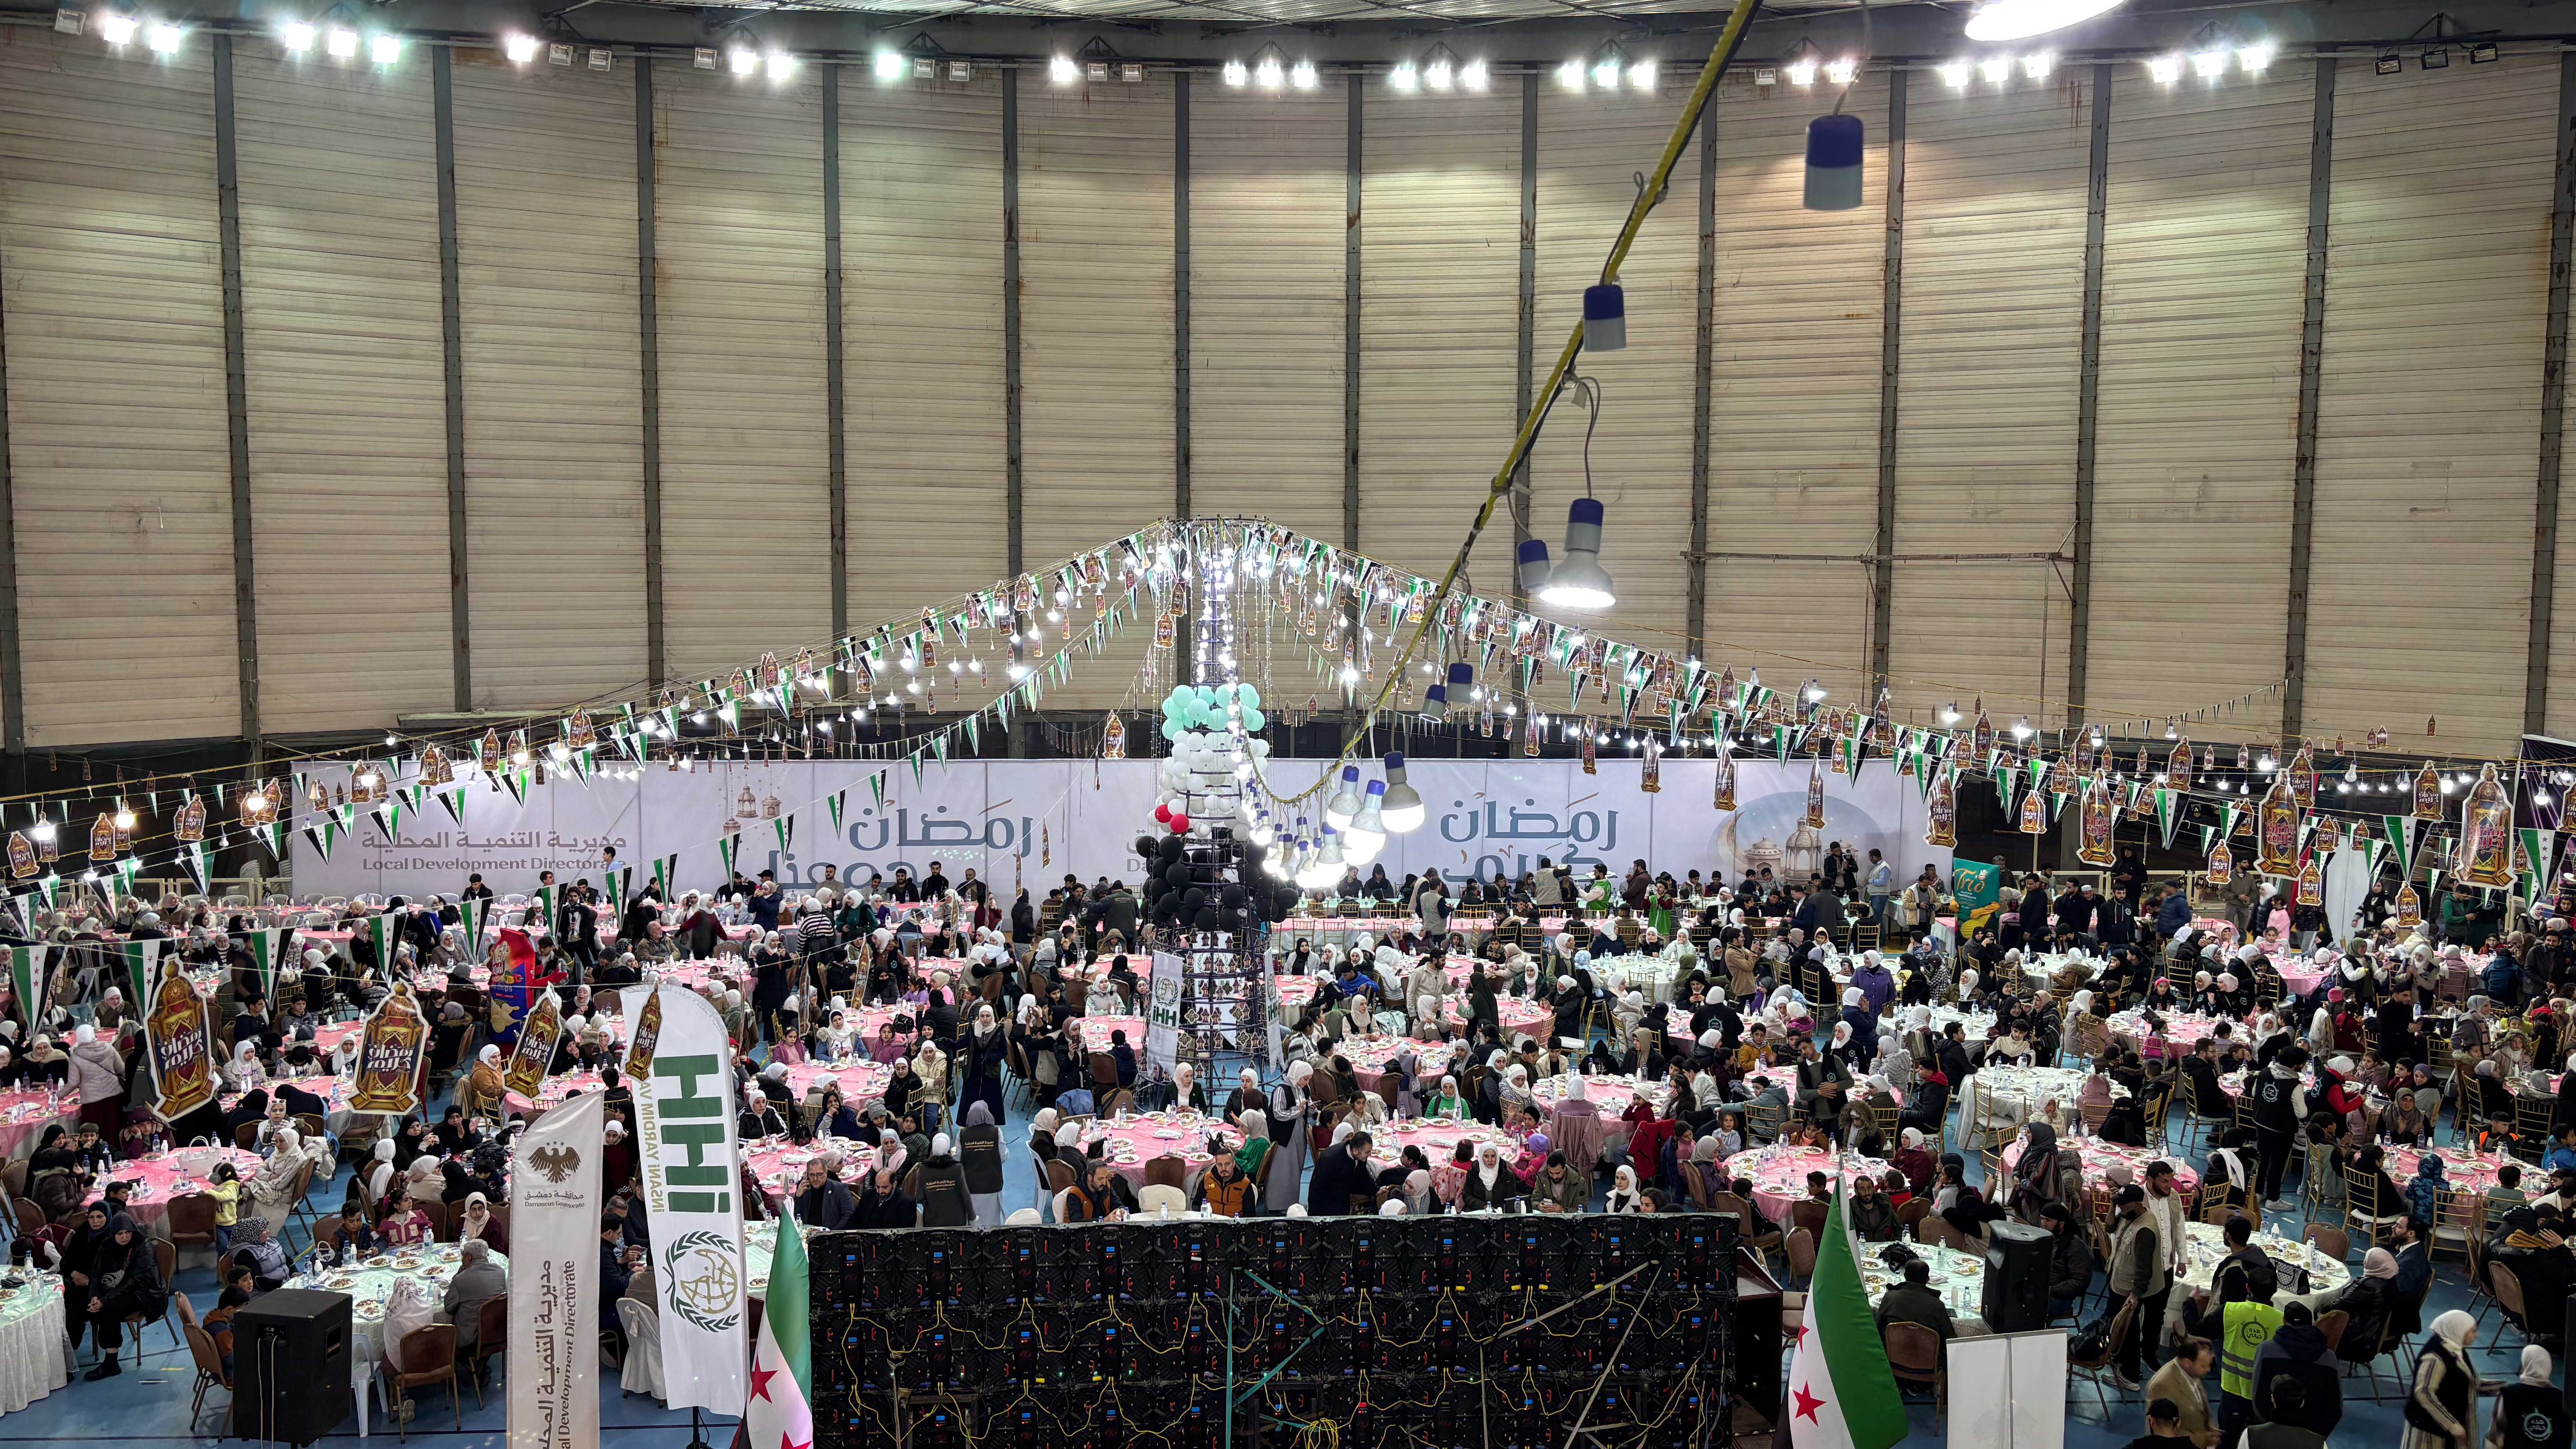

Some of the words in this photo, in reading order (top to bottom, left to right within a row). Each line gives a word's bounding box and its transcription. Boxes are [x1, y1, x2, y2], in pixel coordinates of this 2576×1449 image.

[361, 830, 449, 852] المحلية
[456, 830, 541, 852] التنمية
[547, 830, 627, 854] مديرية
[363, 858, 409, 870] Local
[413, 858, 527, 873] Development
[530, 858, 627, 870] Directorae
[161, 1027, 202, 1056] رمضان
[368, 1043, 414, 1060] رمضان
[162, 1039, 205, 1072] كريم
[367, 1055, 412, 1071] كريم
[524, 1191, 552, 1200] دمشق
[554, 1190, 584, 1200] محافظة
[534, 1260, 558, 1324] مديرية
[565, 1260, 575, 1338] Directorate
[535, 1329, 561, 1395] التنمية
[558, 1339, 574, 1435] Development
[538, 1400, 554, 1449] المحل
